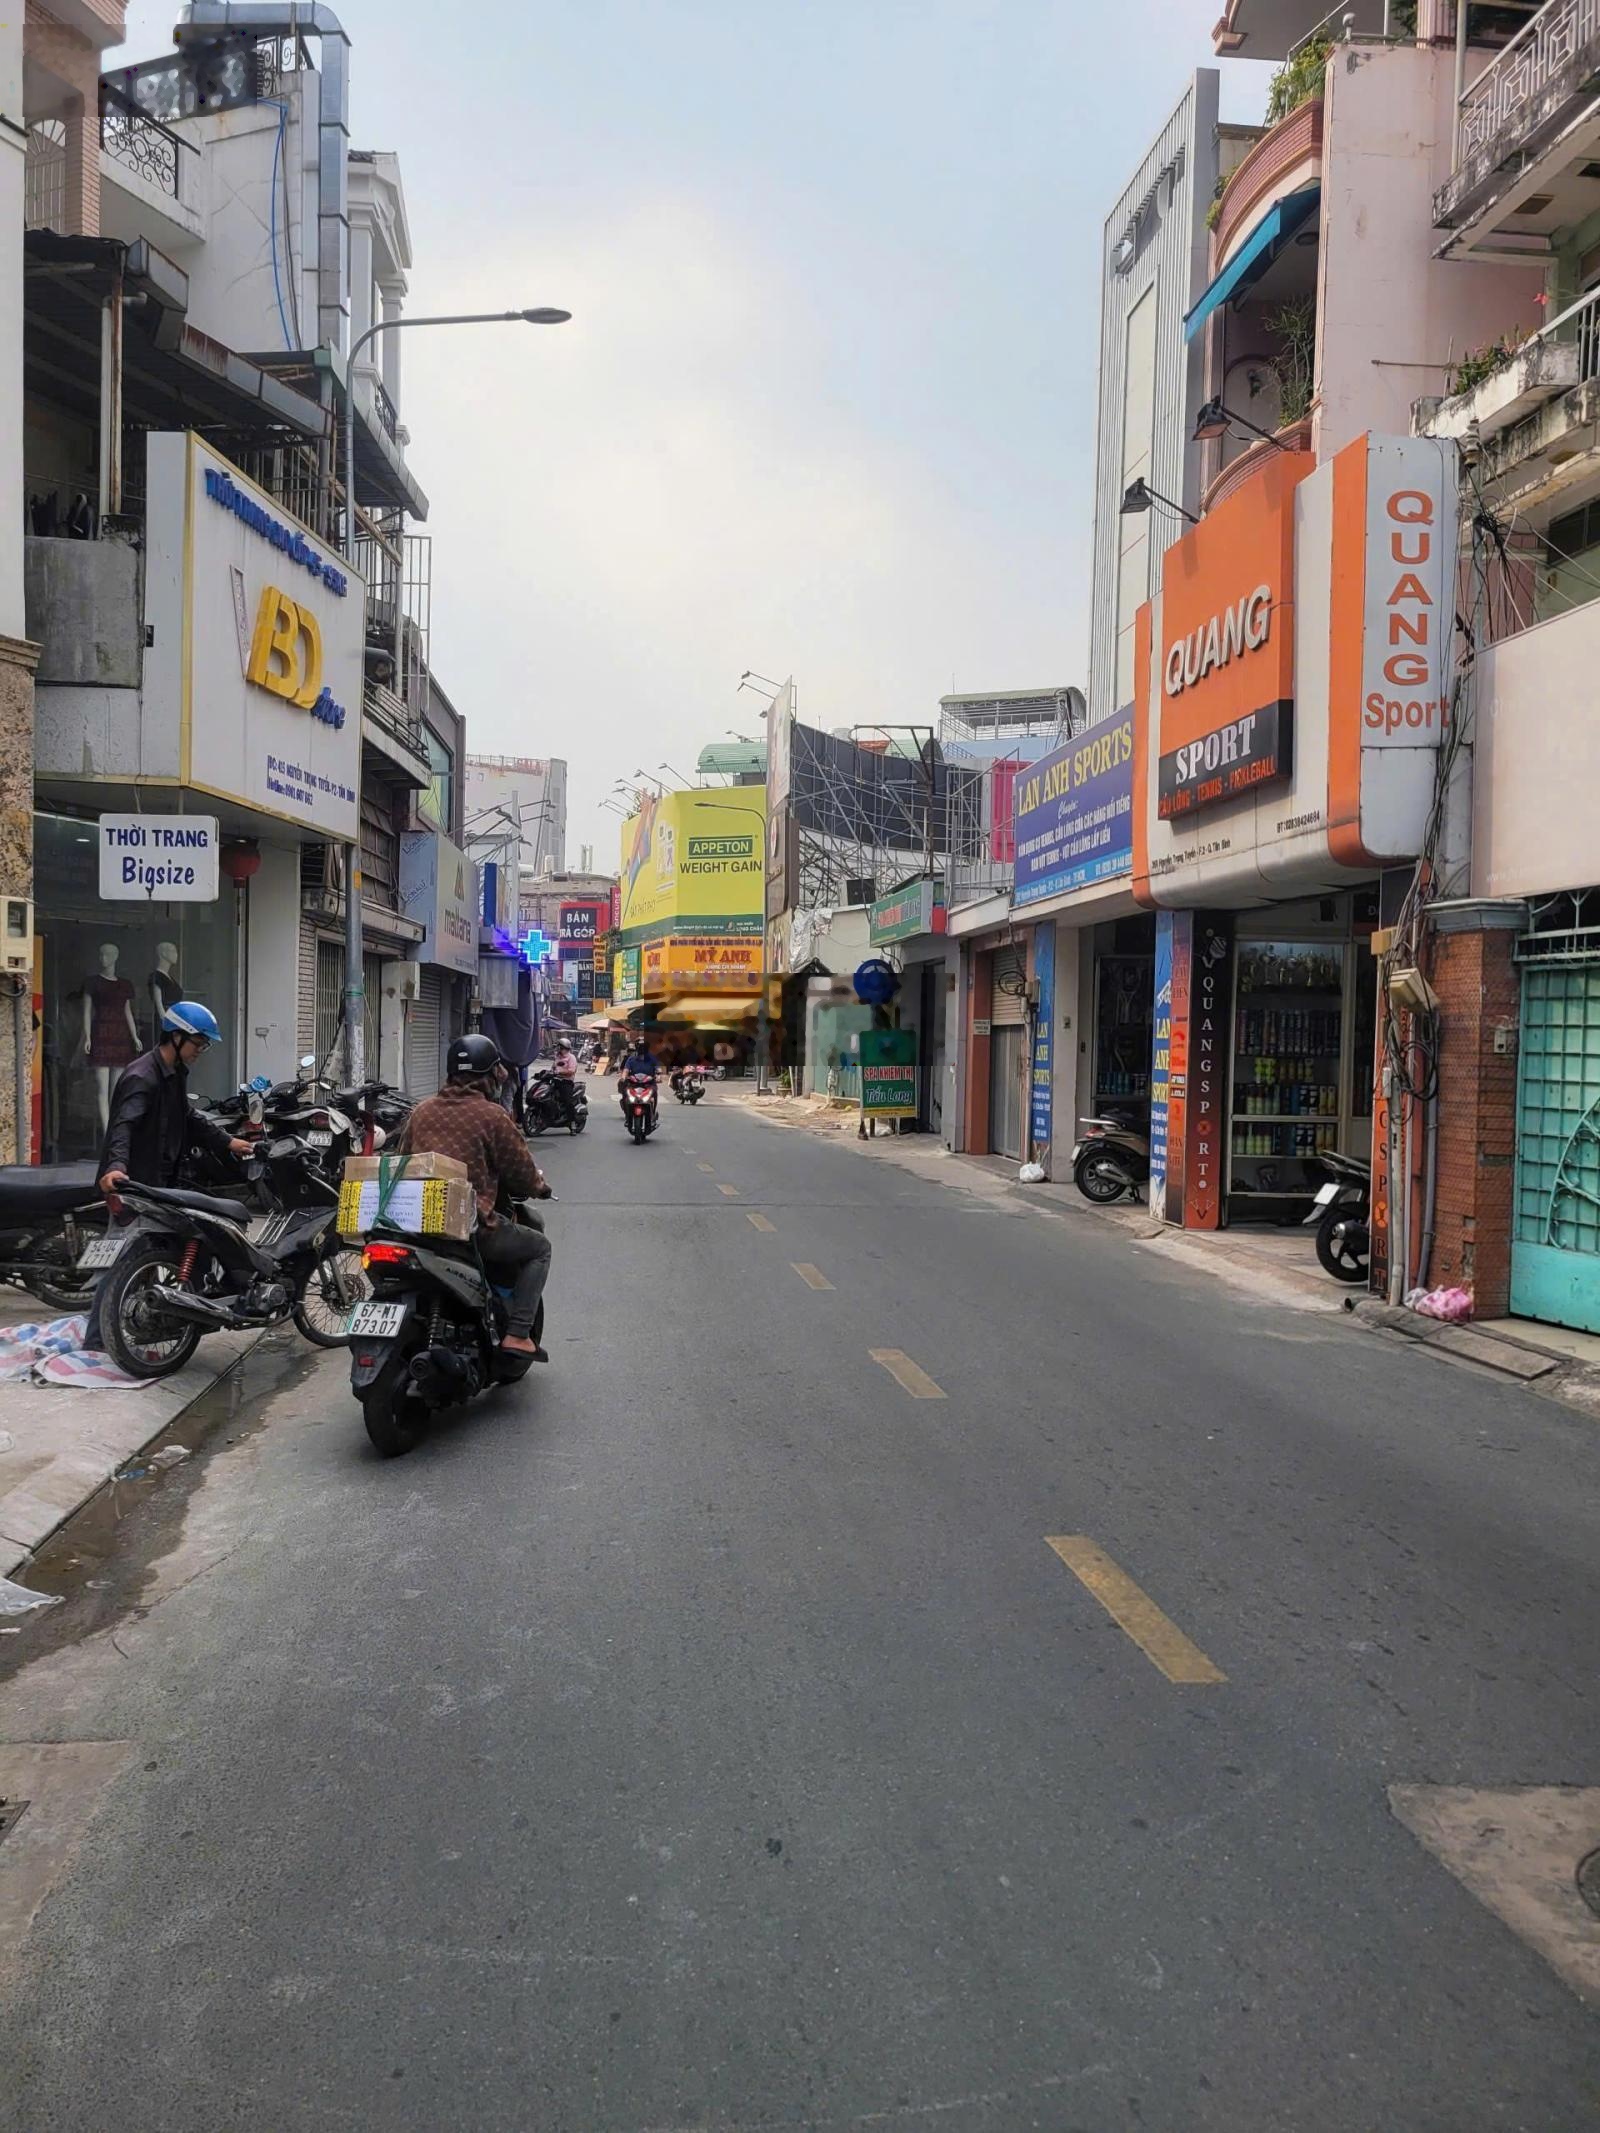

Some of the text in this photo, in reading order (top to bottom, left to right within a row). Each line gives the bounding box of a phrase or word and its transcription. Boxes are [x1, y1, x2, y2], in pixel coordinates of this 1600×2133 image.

[1383, 490, 1434, 686] QUANG
[1165, 584, 1272, 697] QUANG
[1364, 692, 1451, 736] Sport
[1175, 714, 1256, 785] SPORT
[1018, 724, 1132, 817] LAN ANH SPORTS
[1197, 775, 1223, 803] TENNIS
[1229, 755, 1276, 793] PICKLEBALL
[105, 824, 208, 848] THỜI TRANG
[692, 841, 749, 854] APPETON
[122, 856, 194, 892] Bigsize
[680, 860, 762, 874] WEIGHT GAIN
[566, 911, 589, 923] BÁN
[573, 925, 596, 938] GÓP
[720, 950, 752, 963] ANH
[863, 1066, 878, 1081] SPA
[360, 1304, 398, 1320] 67-N1
[351, 1318, 397, 1336] 873.07
